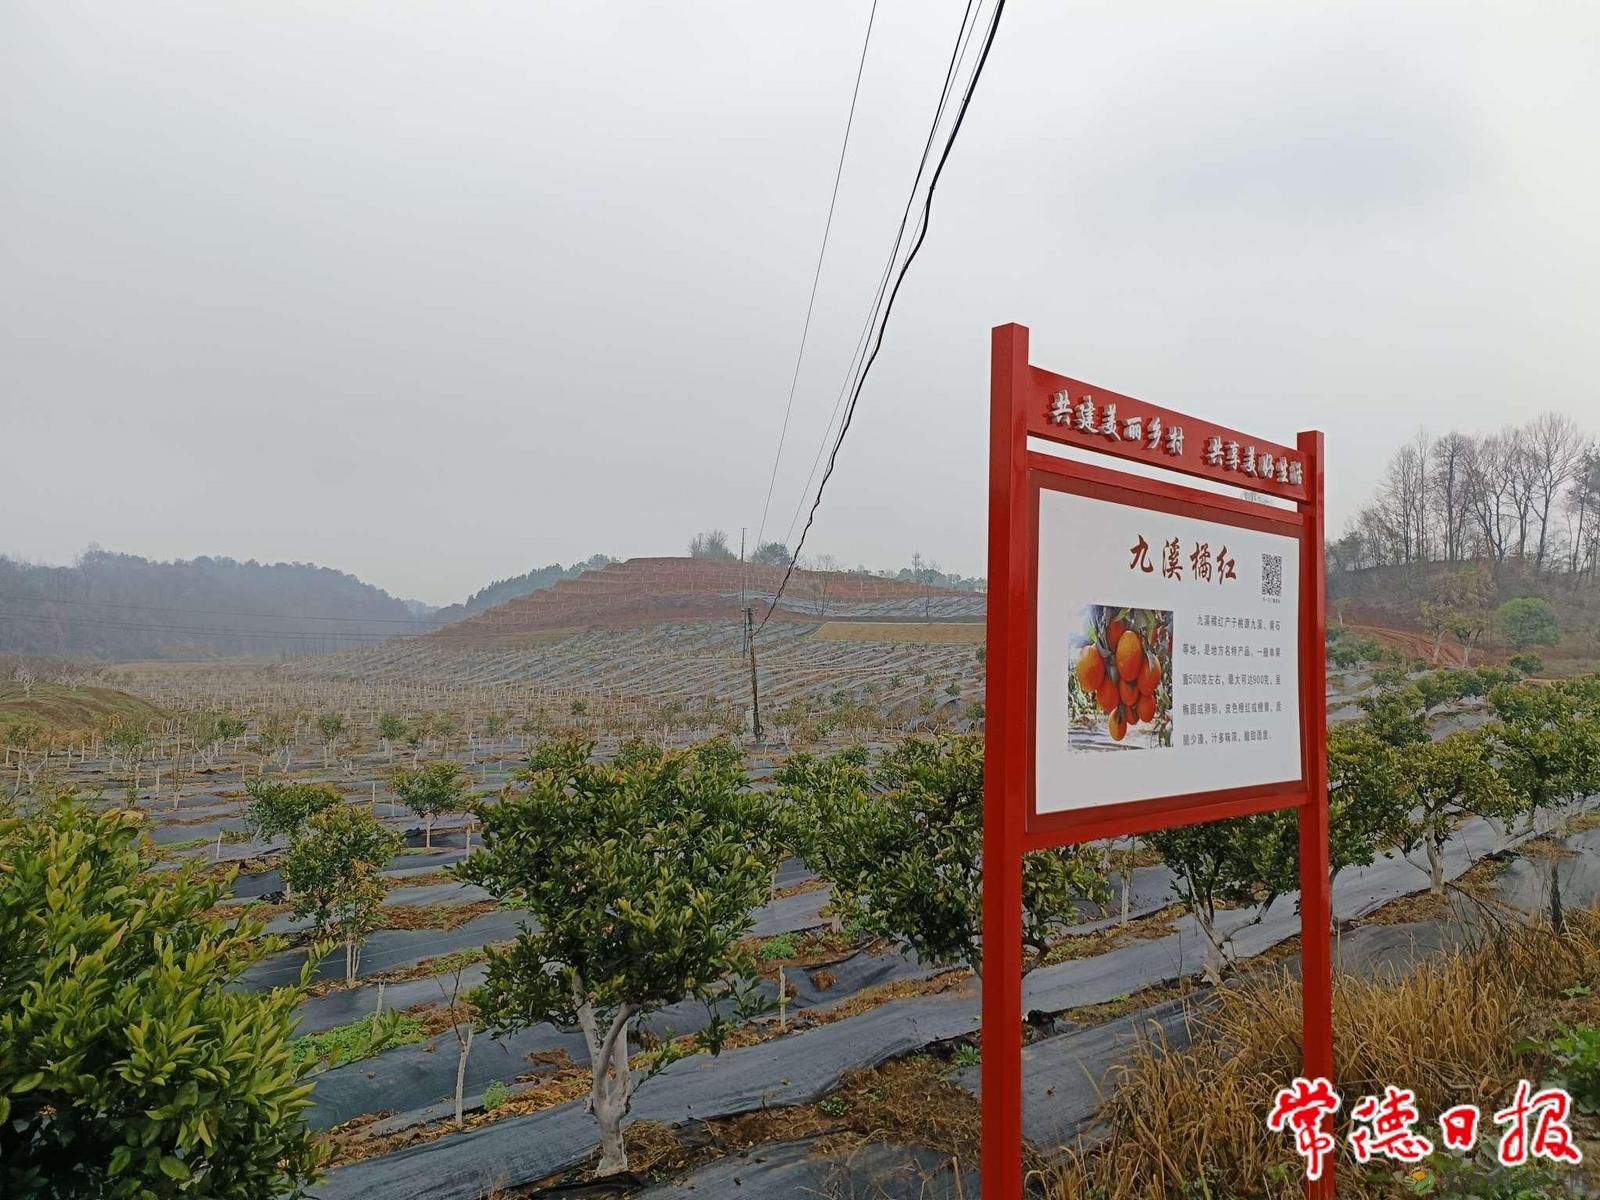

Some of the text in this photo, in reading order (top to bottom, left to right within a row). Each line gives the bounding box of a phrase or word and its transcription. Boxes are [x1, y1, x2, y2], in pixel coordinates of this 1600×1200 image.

[1049, 389, 1185, 456] 共建美丽乡村
[1129, 534, 1237, 585] 九溪橘红
